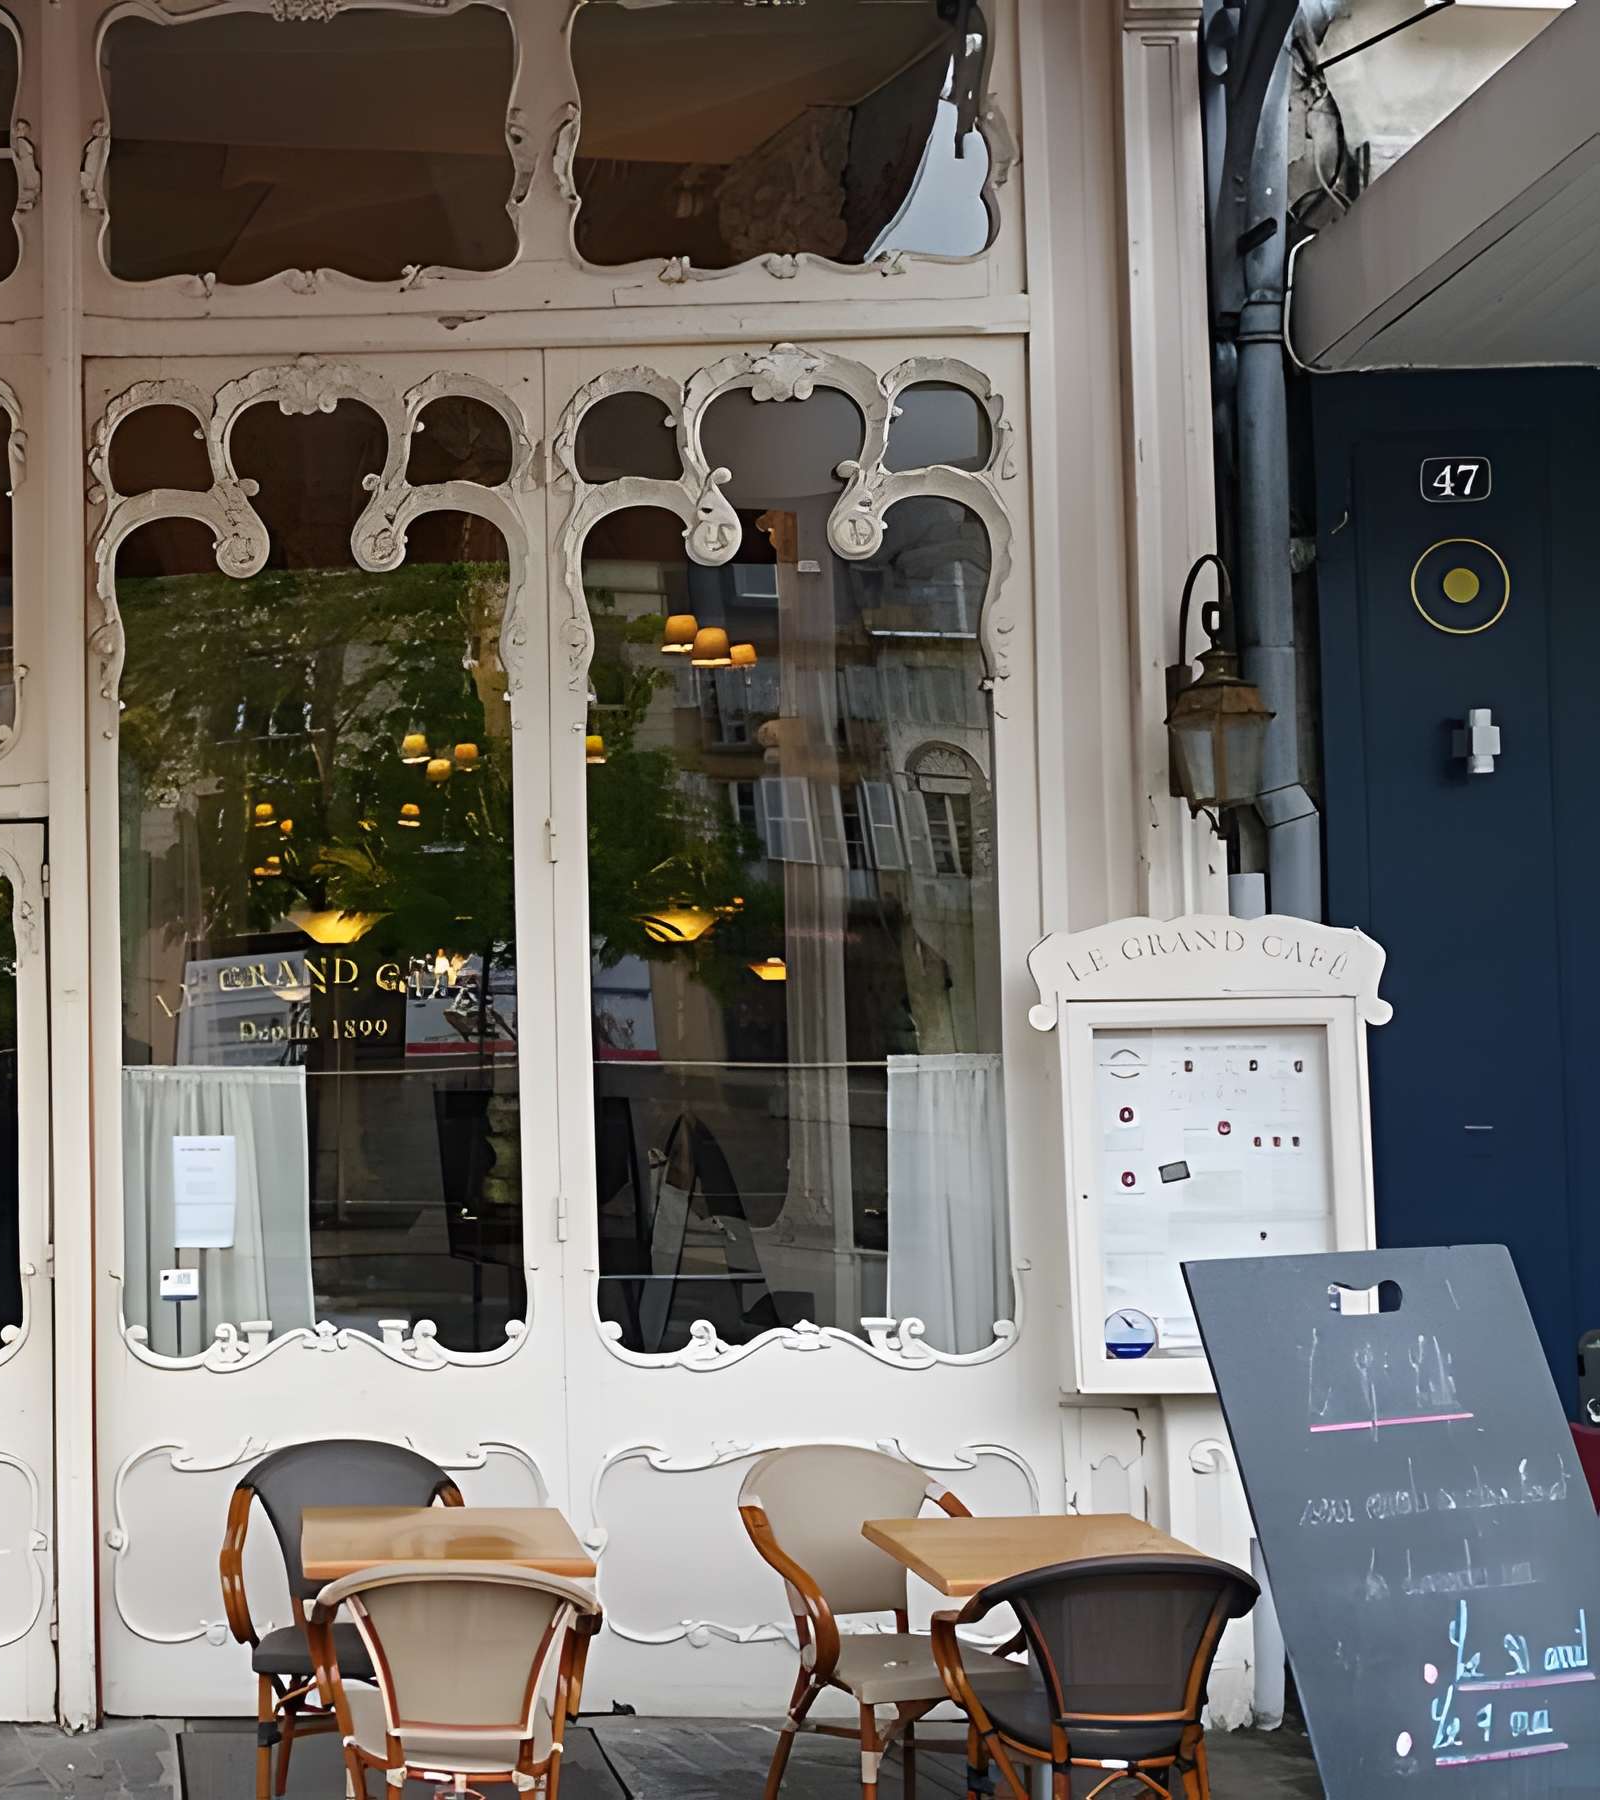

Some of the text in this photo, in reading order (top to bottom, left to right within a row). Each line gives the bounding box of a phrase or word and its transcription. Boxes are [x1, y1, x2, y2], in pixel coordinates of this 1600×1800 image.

[1432, 465, 1479, 497] 47
[1066, 947, 1109, 982] LE
[1121, 929, 1245, 961] GRAND
[331, 1018, 389, 1040] 1899
